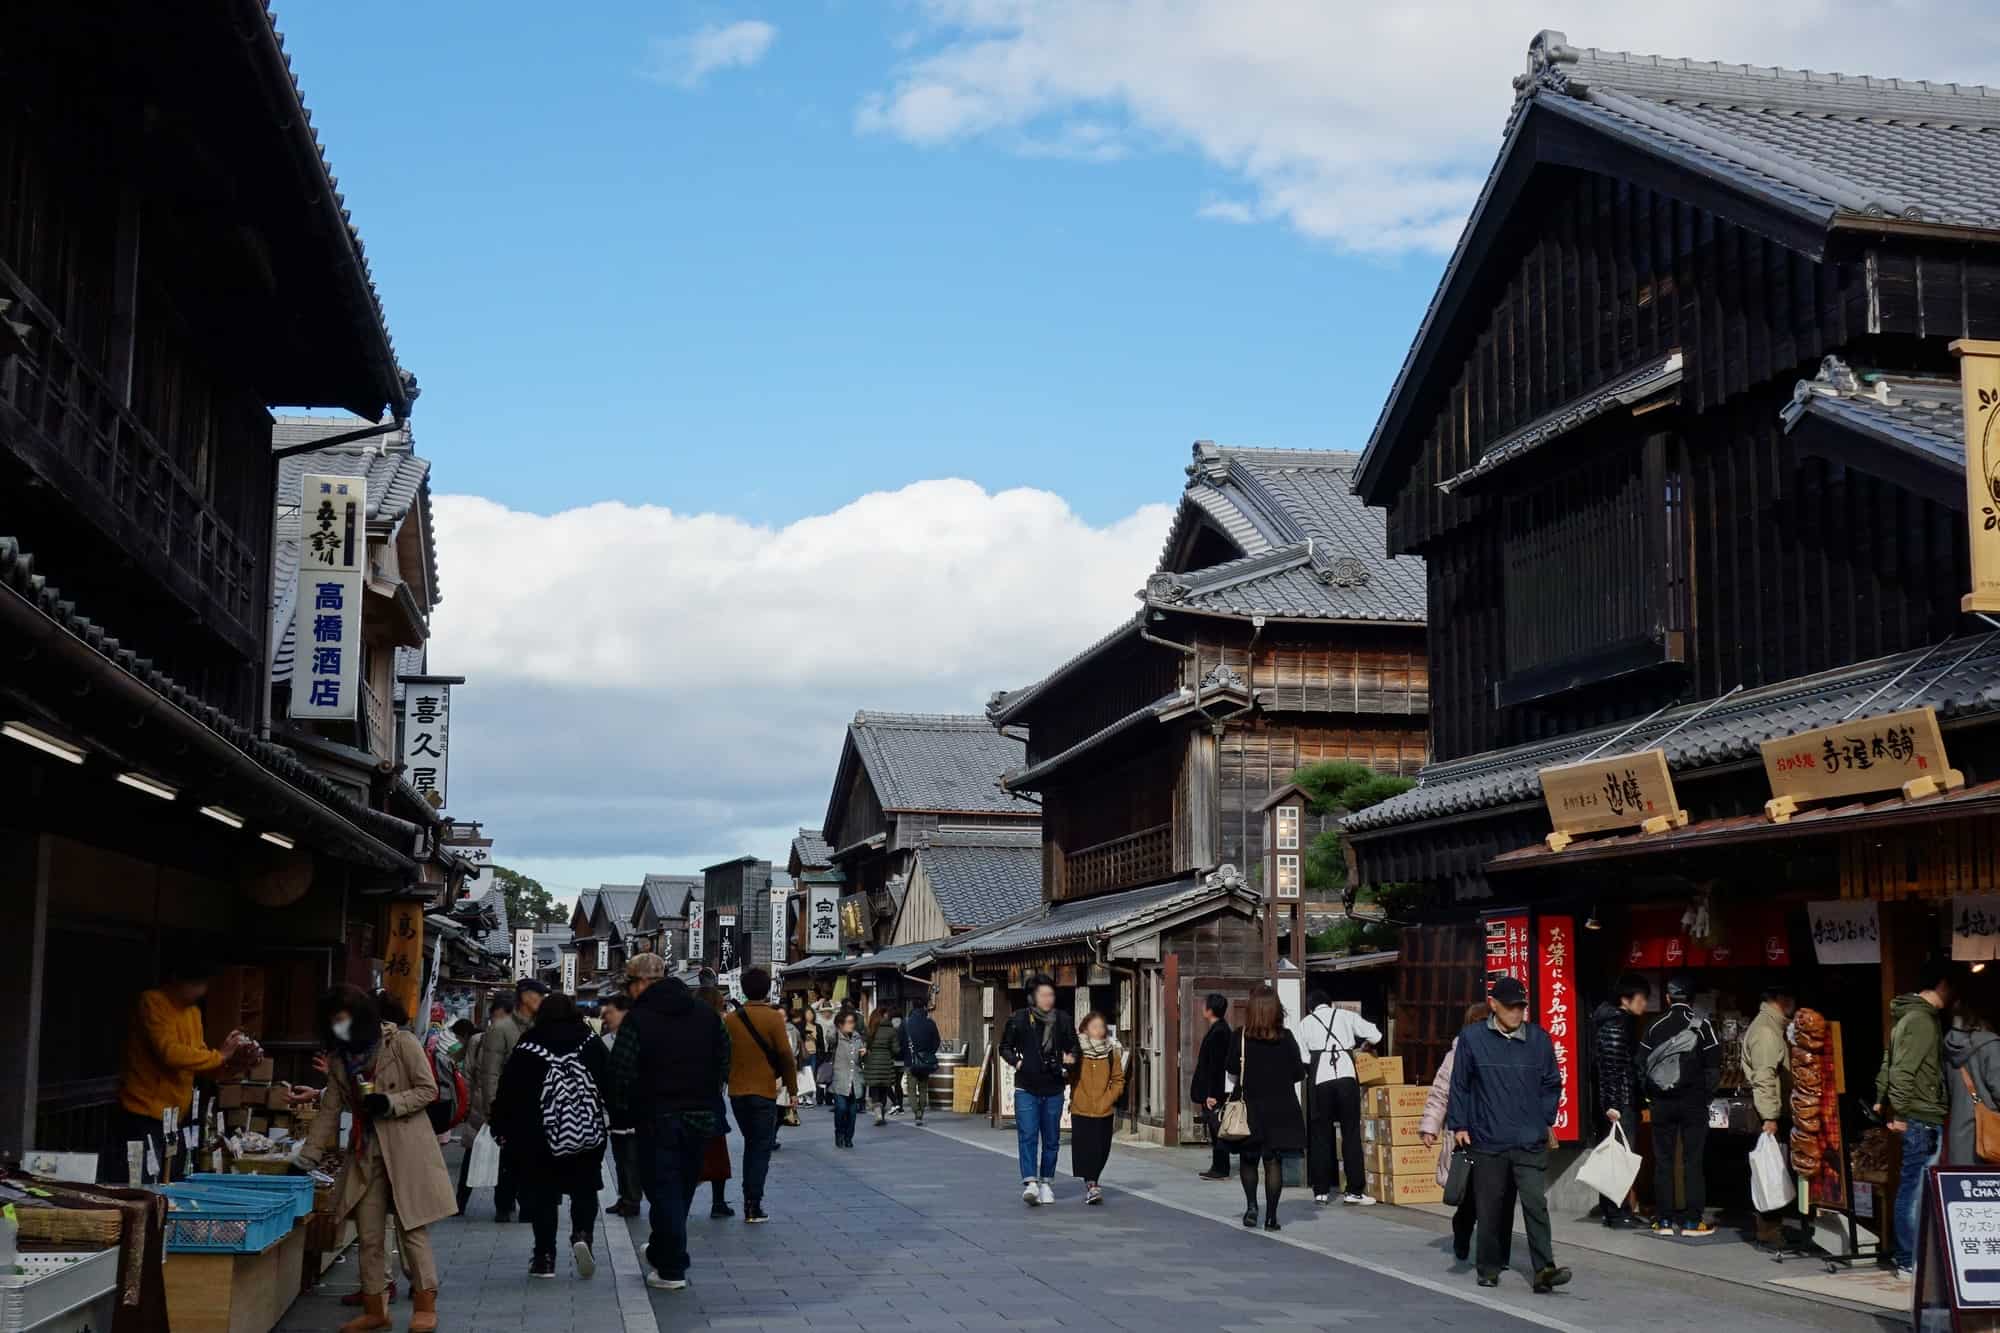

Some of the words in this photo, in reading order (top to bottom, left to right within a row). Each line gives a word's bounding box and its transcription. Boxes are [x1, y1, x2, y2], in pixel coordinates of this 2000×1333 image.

[309, 582, 344, 706] 高橋酒店
[410, 696, 442, 794] 喜久屋
[1823, 726, 1915, 774] 寺子屋本舗
[813, 898, 837, 939] 白鷹
